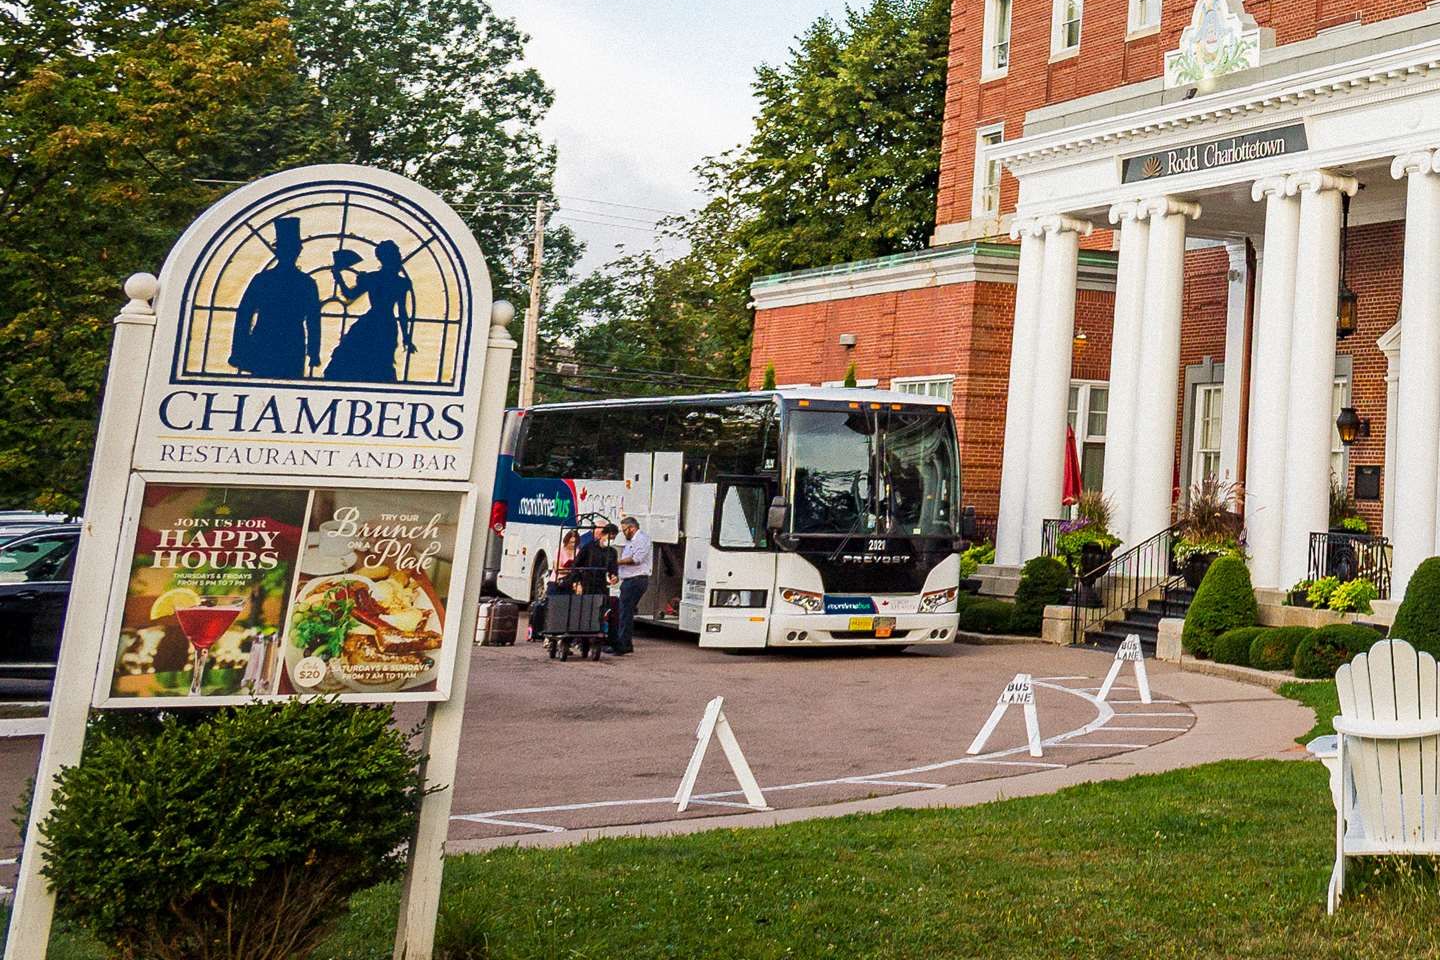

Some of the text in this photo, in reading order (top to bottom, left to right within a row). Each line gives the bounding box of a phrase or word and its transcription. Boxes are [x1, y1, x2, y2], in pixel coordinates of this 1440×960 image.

[1167, 138, 1285, 175] Rodd Charlottetown
[158, 390, 465, 441] CHAMBERS
[160, 444, 457, 471] RESTAURANT AND BAR
[174, 518, 267, 528] JOIN US FOR
[327, 506, 442, 539] Brunch
[381, 513, 419, 522] TRY OUR
[155, 529, 281, 550] HAPPY
[347, 541, 361, 549] ON
[868, 540, 886, 551] 2021
[150, 550, 280, 570] HOURS
[363, 538, 442, 575] Plate
[1121, 641, 1138, 650] BUS
[1116, 650, 1140, 661] LANE
[331, 663, 380, 672] SATURDAYS
[389, 664, 430, 672] SUNDAYS
[299, 670, 320, 680] $20
[342, 672, 365, 680] FROM
[404, 672, 417, 680] AM
[1007, 682, 1029, 691] BUS
[1001, 692, 1032, 703] LANE
